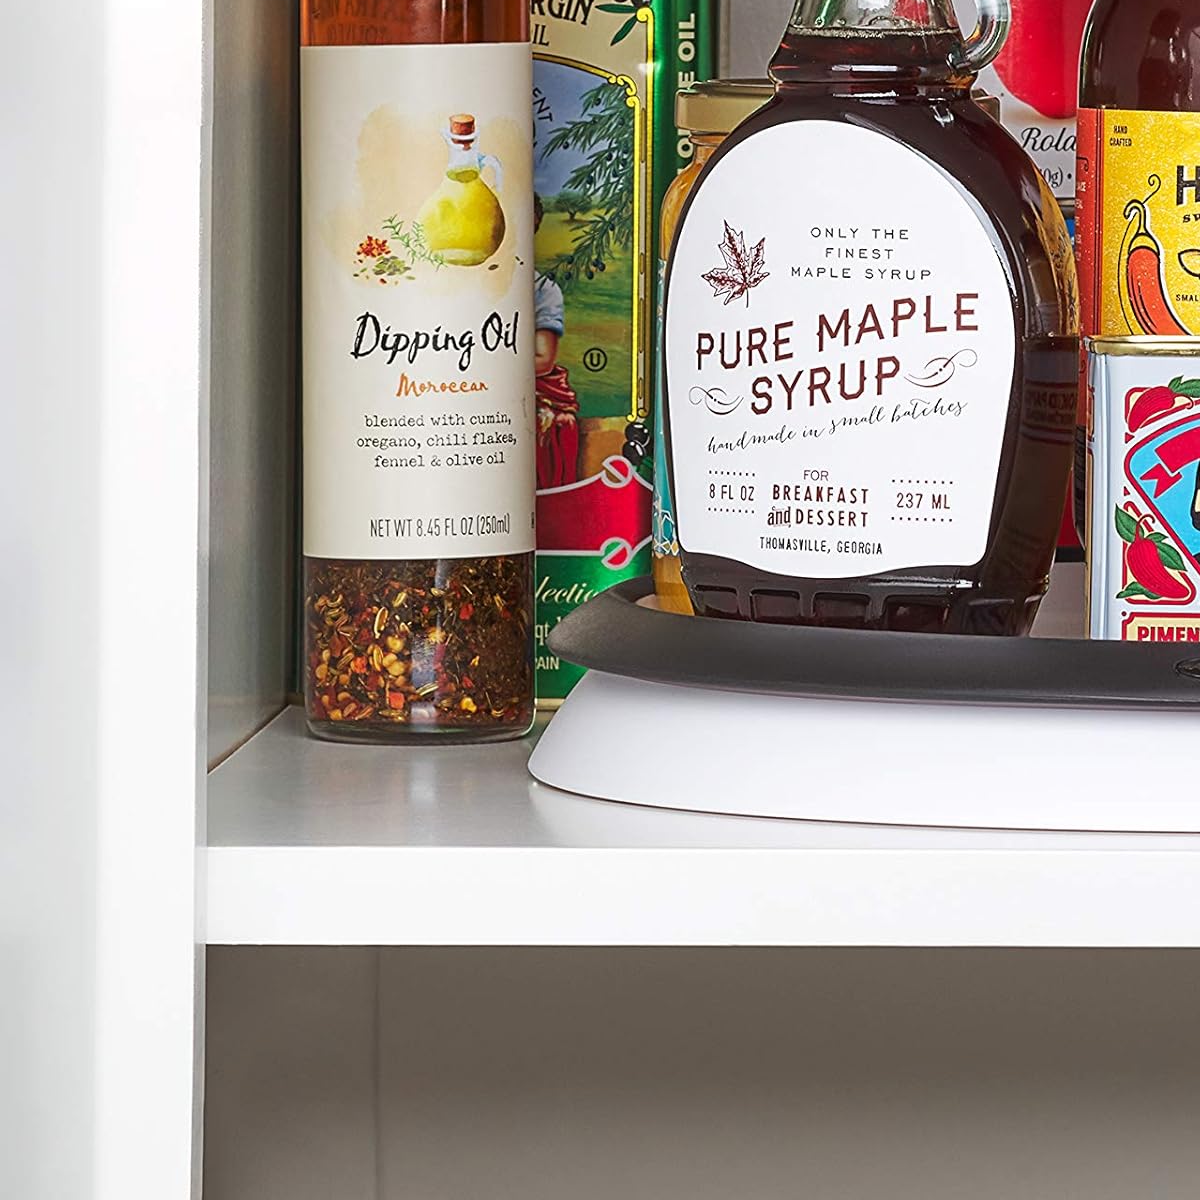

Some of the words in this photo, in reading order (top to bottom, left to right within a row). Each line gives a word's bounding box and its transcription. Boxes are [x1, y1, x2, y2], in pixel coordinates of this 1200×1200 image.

[678, 13, 695, 62] OIL
[1021, 127, 1076, 152] Rola
[1113, 125, 1128, 135] HAND
[1109, 138, 1133, 148] CRAFTED
[810, 227, 858, 240] ONLY
[872, 228, 909, 240] THE
[825, 247, 894, 260] FINEST
[791, 266, 852, 279] MAPLE
[865, 268, 932, 281] SYRUP
[696, 320, 794, 370] PURE
[816, 293, 979, 352] MAPLE
[350, 311, 475, 372] Dipping
[481, 311, 519, 354] Oil
[396, 373, 489, 397] Moroccan
[751, 355, 901, 416] SYRUP
[364, 415, 425, 428] blended
[431, 413, 466, 427] with
[469, 411, 512, 427] cumin,
[708, 428, 797, 454] handmade
[802, 425, 825, 439] in
[830, 406, 887, 436] small
[890, 397, 969, 423] batches
[357, 436, 421, 451] oregano,
[426, 433, 468, 448] chili
[472, 431, 517, 446] flakes,
[374, 455, 425, 468] fennel
[431, 456, 442, 467] &
[446, 453, 483, 466] olive
[486, 452, 505, 465] oil
[803, 469, 829, 482] FOR
[709, 483, 716, 499] 8
[721, 484, 734, 500] FL
[740, 485, 755, 502] OZ
[772, 484, 869, 505] BREAKFAST
[896, 492, 922, 510] 237
[931, 494, 951, 510] ML
[370, 519, 392, 537] NET
[393, 519, 412, 537] WT
[416, 518, 440, 537] 8.45
[444, 518, 457, 537] FL
[461, 517, 474, 536] OZ
[795, 509, 869, 528] DESSERT
[759, 536, 831, 554] THOMASVILLE,
[836, 540, 883, 556] GEORGIA
